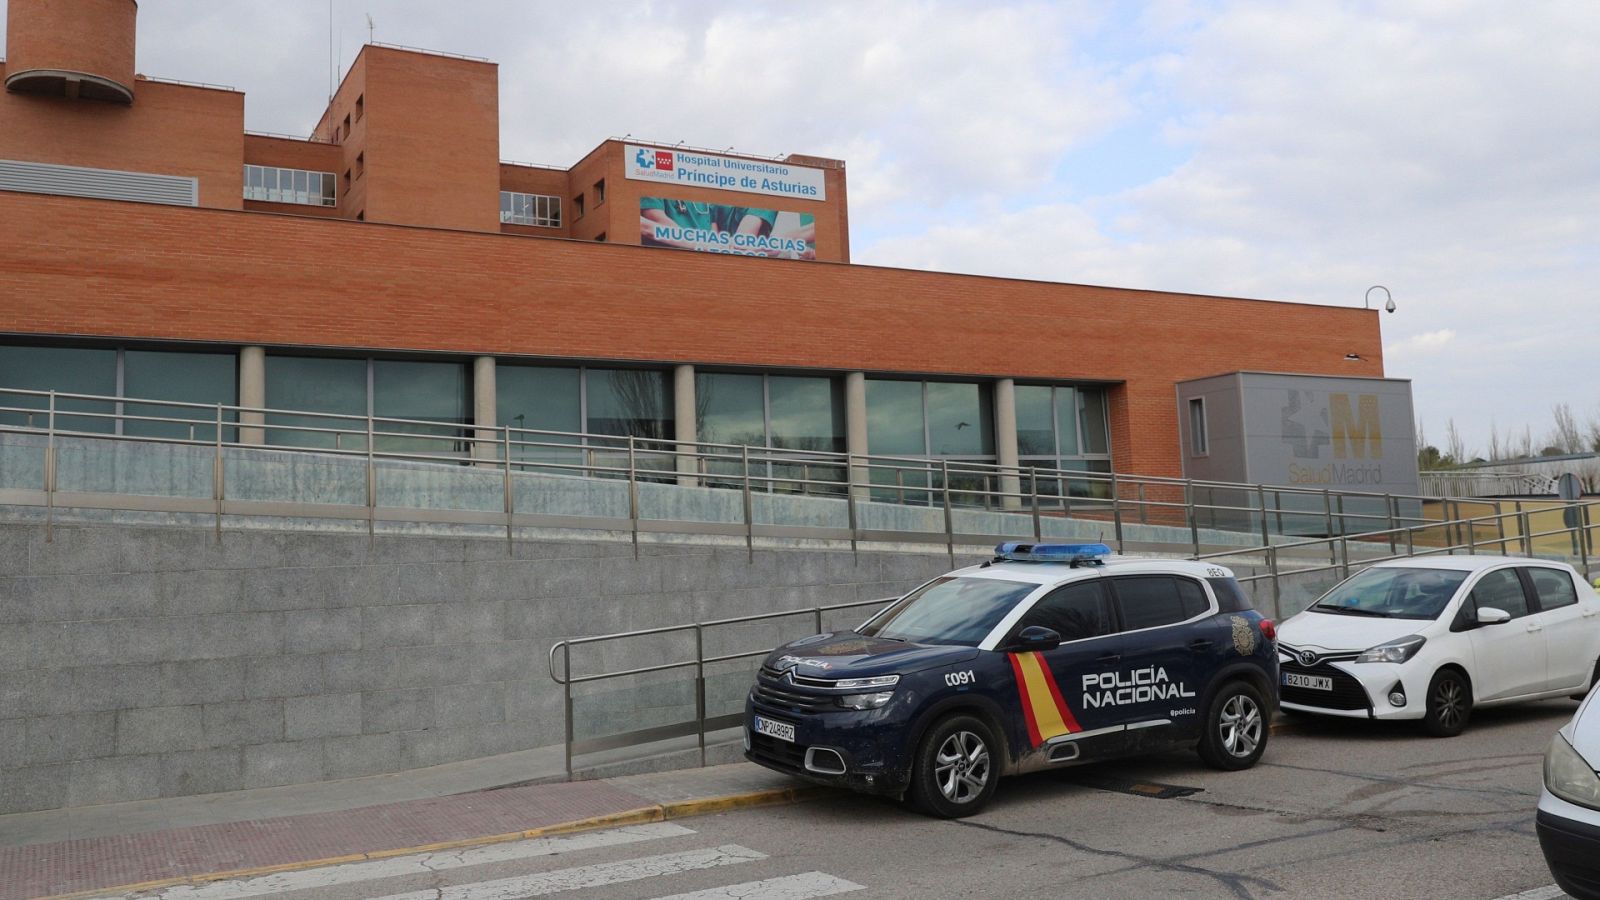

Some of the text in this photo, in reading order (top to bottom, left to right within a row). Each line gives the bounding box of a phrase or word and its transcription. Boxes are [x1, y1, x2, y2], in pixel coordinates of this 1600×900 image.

[635, 168, 675, 179] SaludMadrid
[677, 153, 789, 176] Hospital Universitario
[677, 168, 817, 195] Príncipe de Asturias
[655, 226, 806, 251] MUCHAS GRACIAS
[1288, 463, 1382, 484] SaludMadrid
[1082, 665, 1169, 690] POLICÍA
[1287, 675, 1330, 689] 8210 JWX
[1083, 682, 1196, 709] NACIONAL
